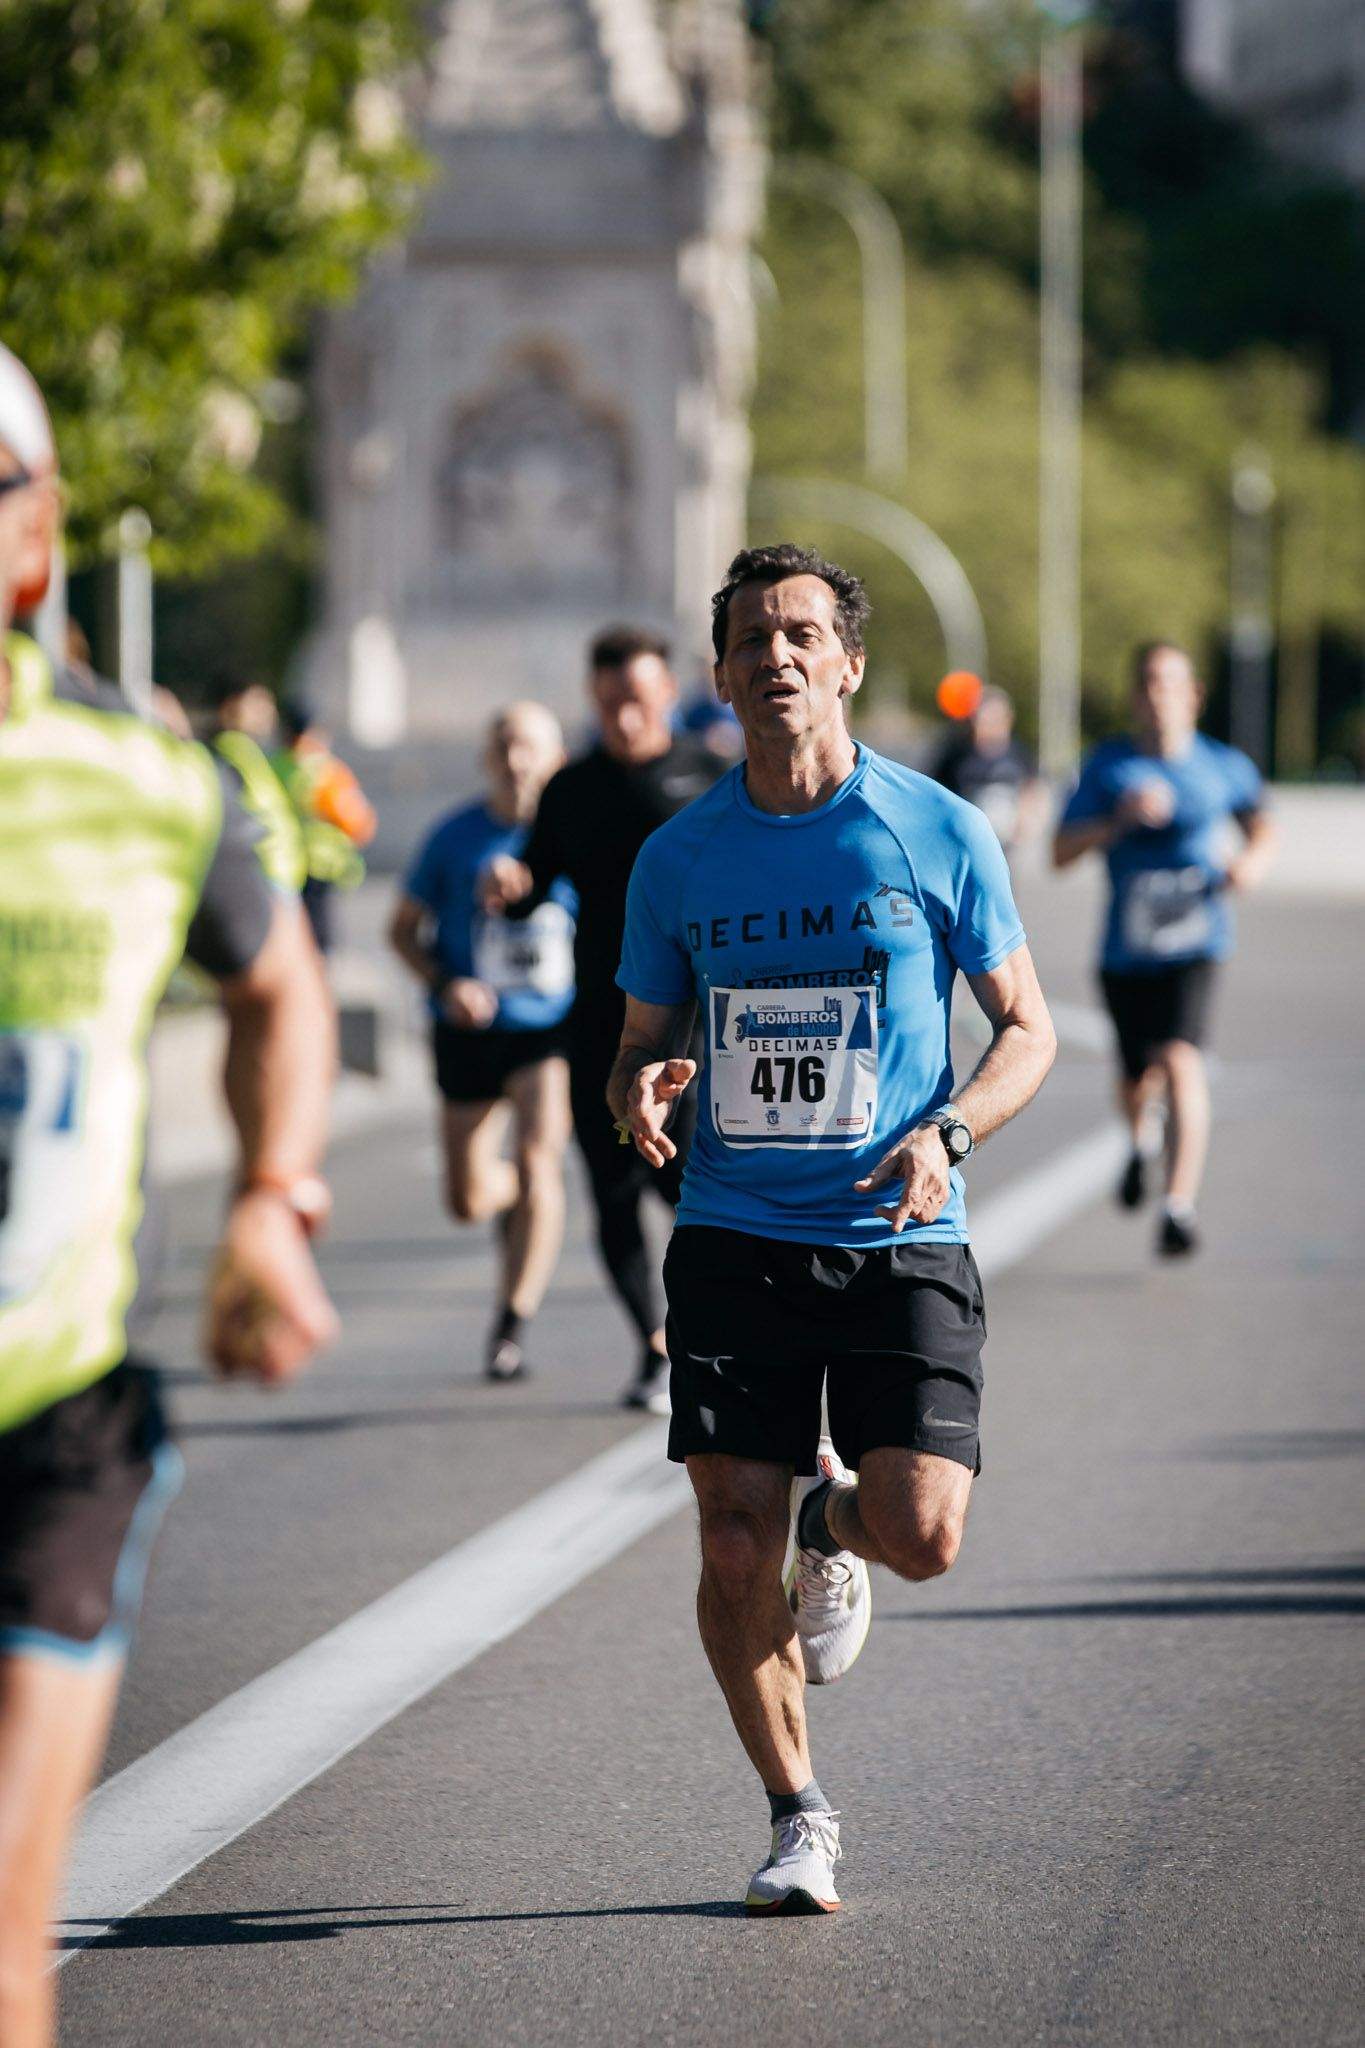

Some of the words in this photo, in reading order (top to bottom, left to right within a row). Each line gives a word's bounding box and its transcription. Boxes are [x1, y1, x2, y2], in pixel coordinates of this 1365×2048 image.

[687, 898, 913, 952] DECIMAS
[757, 1012, 839, 1025] BOMBEROS
[787, 1026, 799, 1036] de
[801, 1023, 840, 1036] MADRID
[749, 1038, 837, 1052] DECIMAS
[751, 1056, 826, 1103] 476
